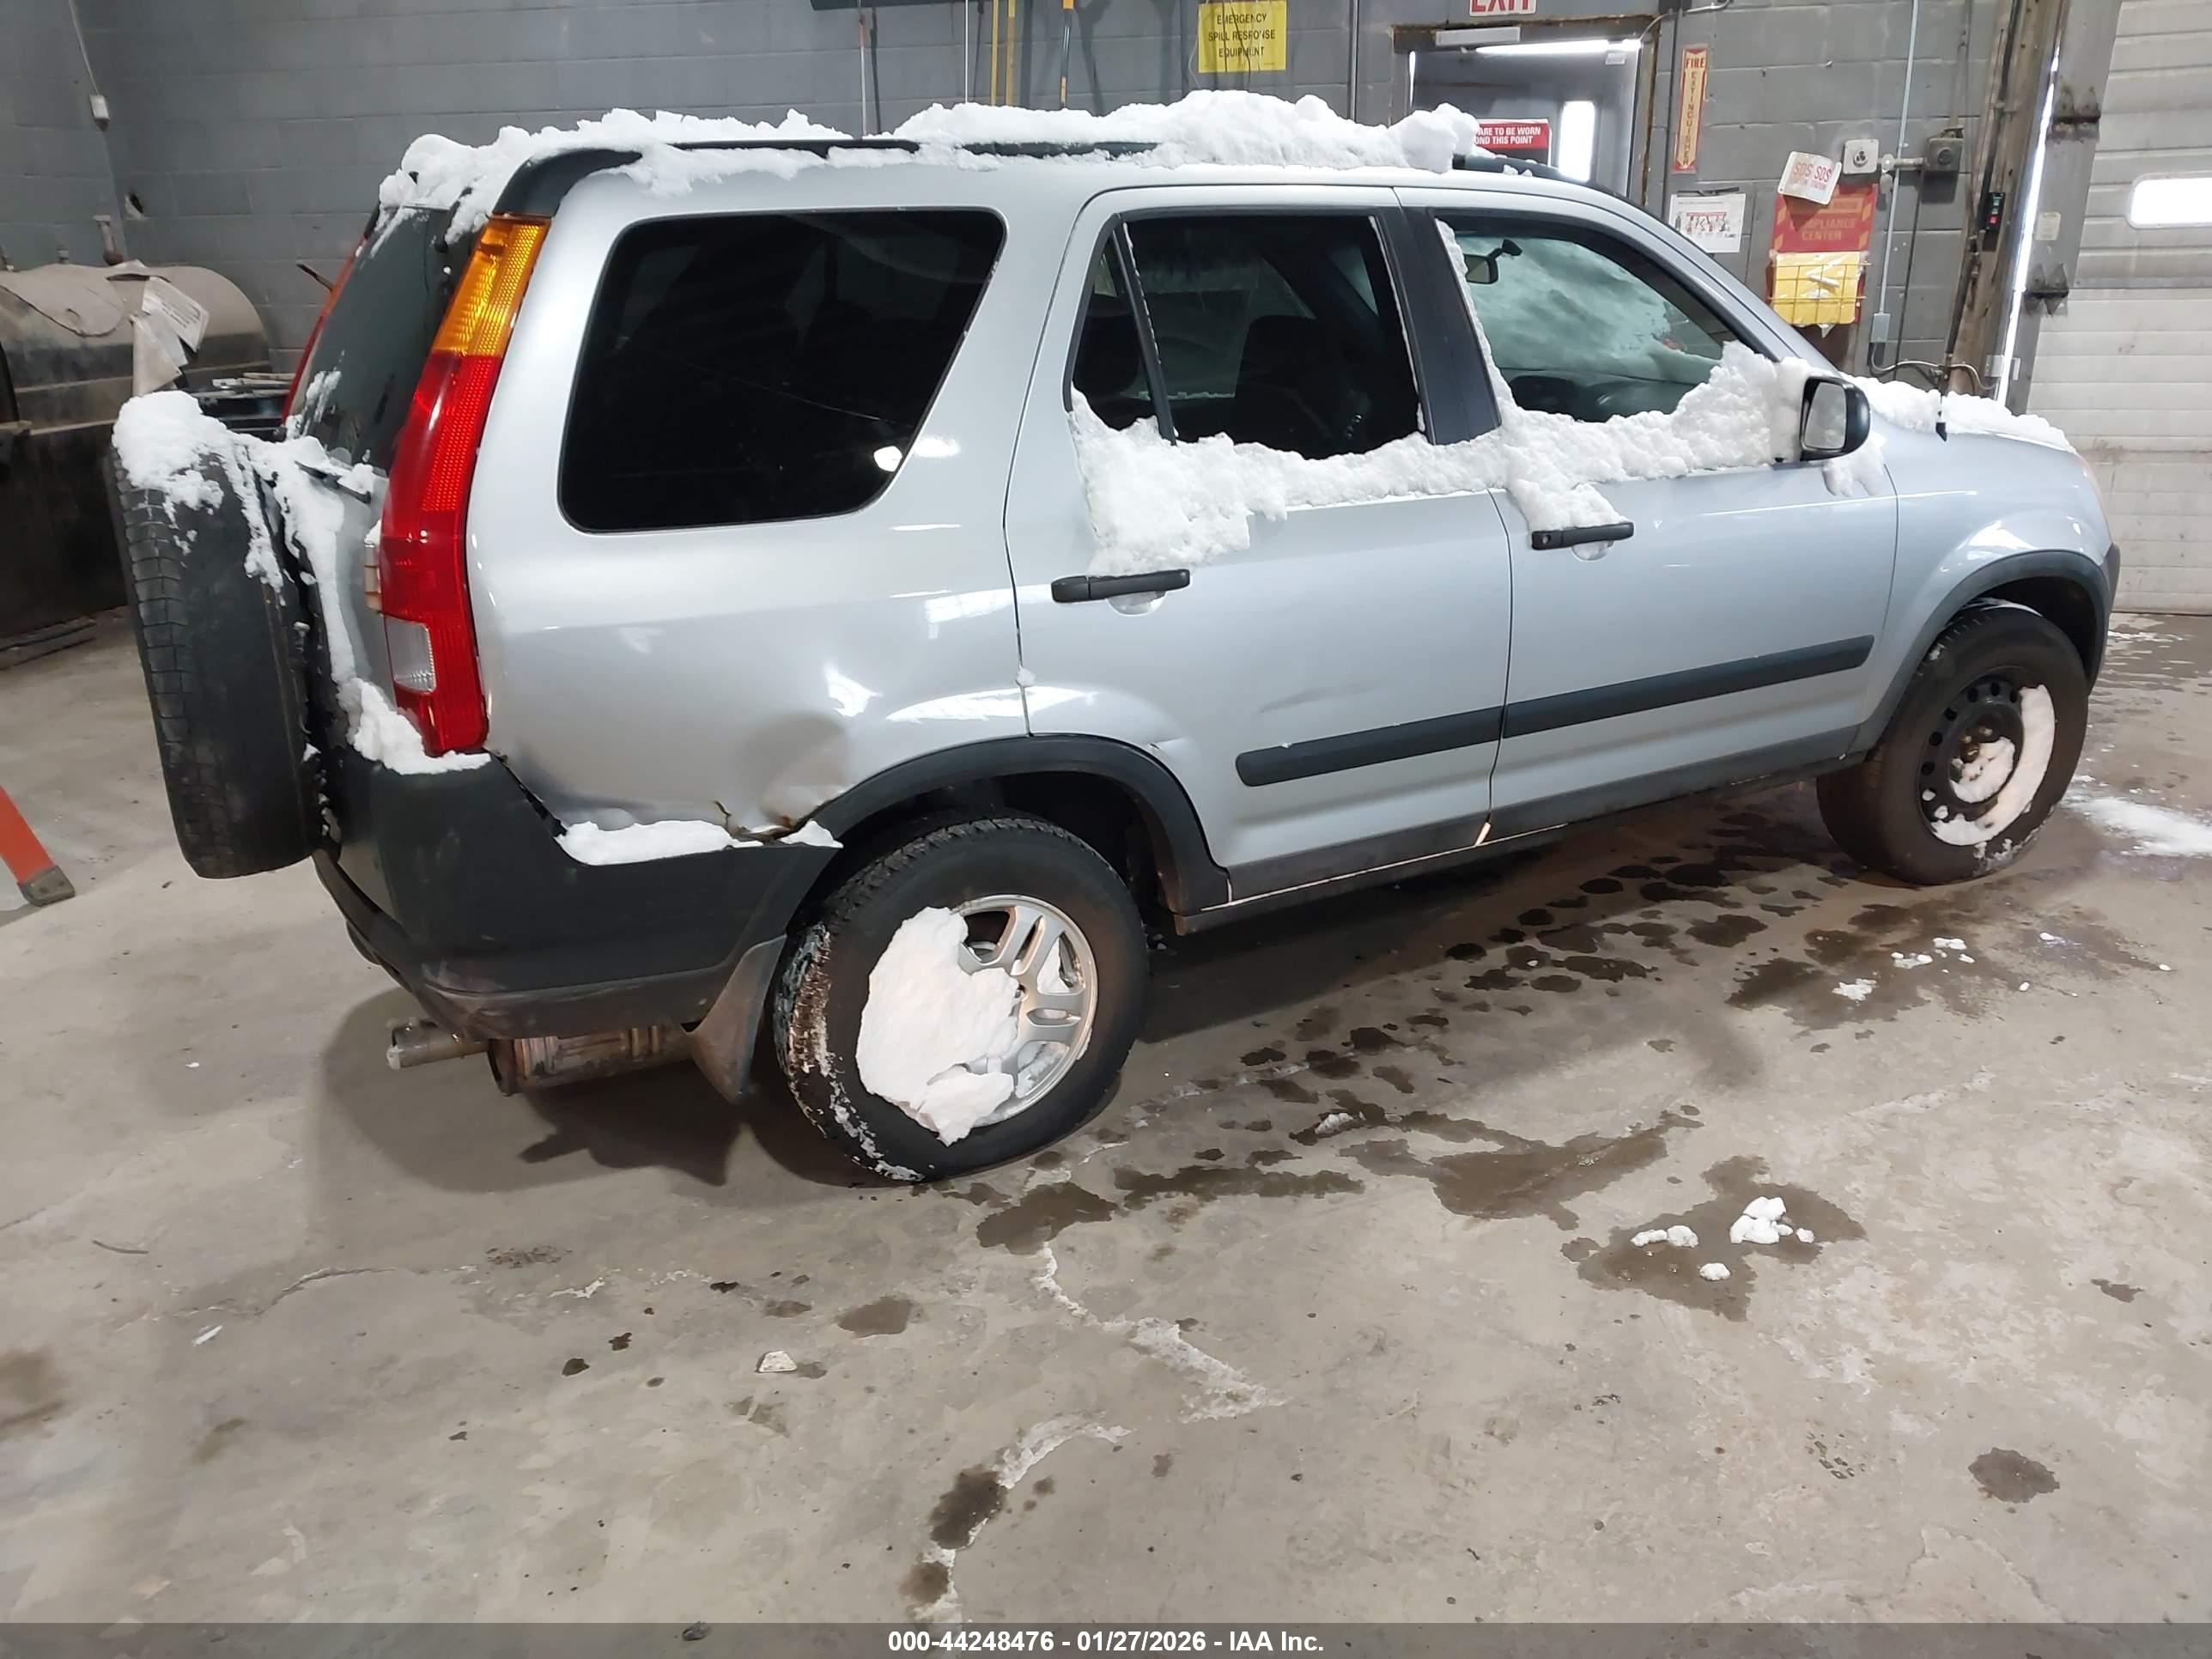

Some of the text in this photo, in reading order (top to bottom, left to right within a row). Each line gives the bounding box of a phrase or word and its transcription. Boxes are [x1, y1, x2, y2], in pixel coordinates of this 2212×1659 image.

[1217, 13, 1267, 25] EMERGENCY
[1208, 29, 1276, 41] SPILL RESPONSE
[1686, 58, 1705, 70] FIRE
[1682, 71, 1698, 166] EXTINGUISHER
[1494, 127, 1504, 136] TO
[1505, 126, 1516, 136] BE
[1516, 126, 1541, 136] WORN
[1474, 136, 1534, 145] OND THIS POINT
[1802, 231, 1841, 241] CENTER
